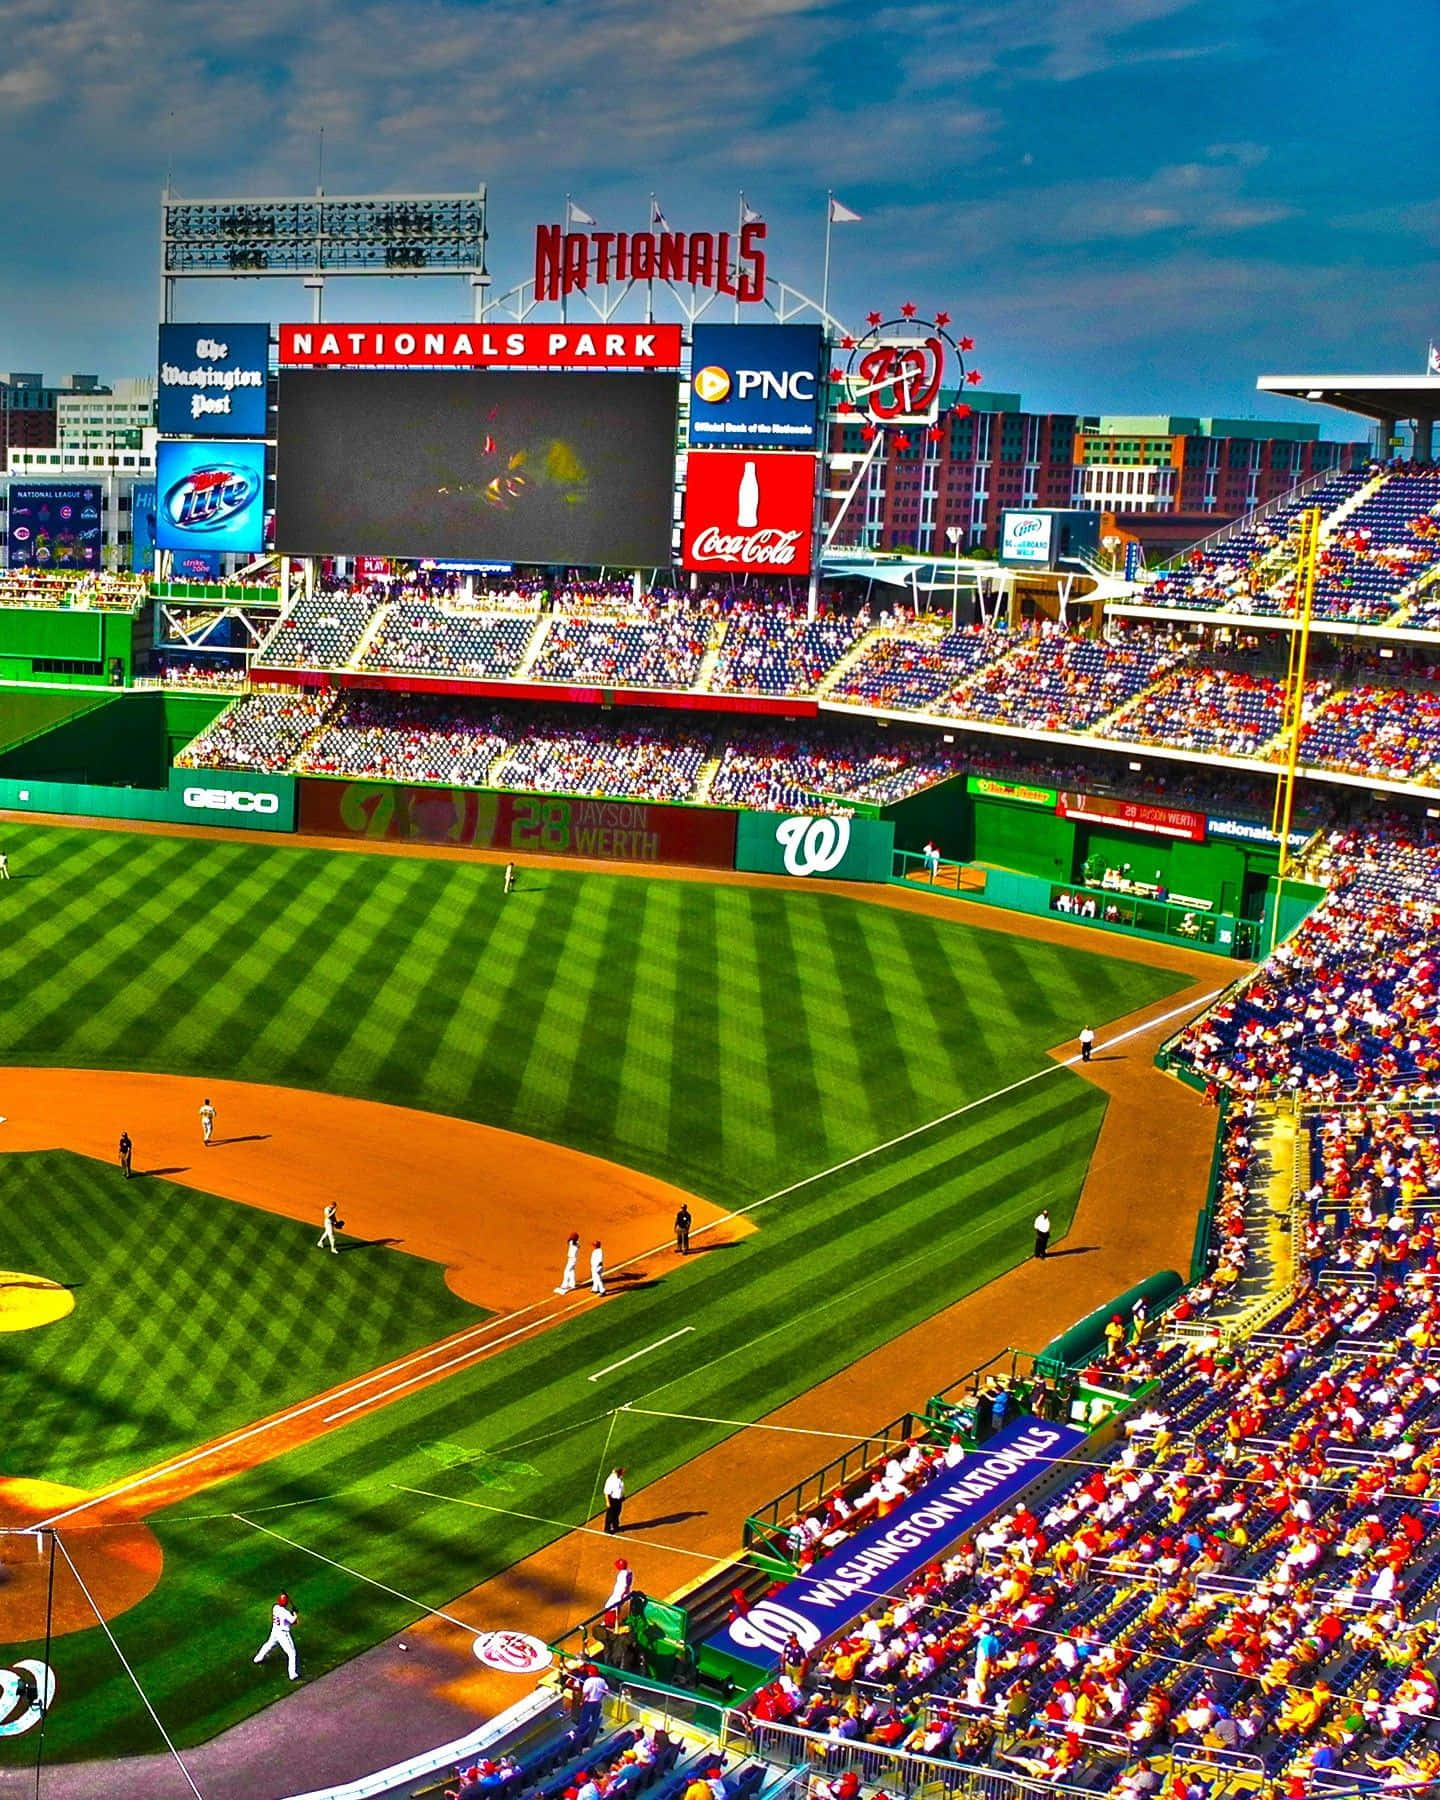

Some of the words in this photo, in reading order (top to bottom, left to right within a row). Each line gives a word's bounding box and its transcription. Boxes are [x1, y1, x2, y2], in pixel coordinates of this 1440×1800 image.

[534, 223, 767, 302] NATIONALS
[196, 338, 228, 361] The
[292, 332, 527, 355] NATIONALS
[548, 333, 656, 357] PARK
[161, 362, 263, 391] Washington
[735, 370, 814, 400] PNC
[191, 394, 231, 419] Post
[693, 421, 724, 432] Official
[725, 422, 747, 433] Bank
[758, 423, 771, 434] the
[772, 423, 813, 434] Nationals
[177, 480, 249, 525] Lite
[692, 526, 804, 566] Coca-Cola
[364, 560, 385, 571] PLAY
[183, 787, 279, 814] GEICO
[575, 800, 648, 829] JAYSON
[1124, 805, 1137, 818] 28
[511, 798, 571, 851] 28
[575, 826, 659, 861] WERTH
[776, 815, 851, 876] W
[799, 1500, 964, 1608] WASHINGTON
[948, 1426, 1061, 1512] NATIONALS
